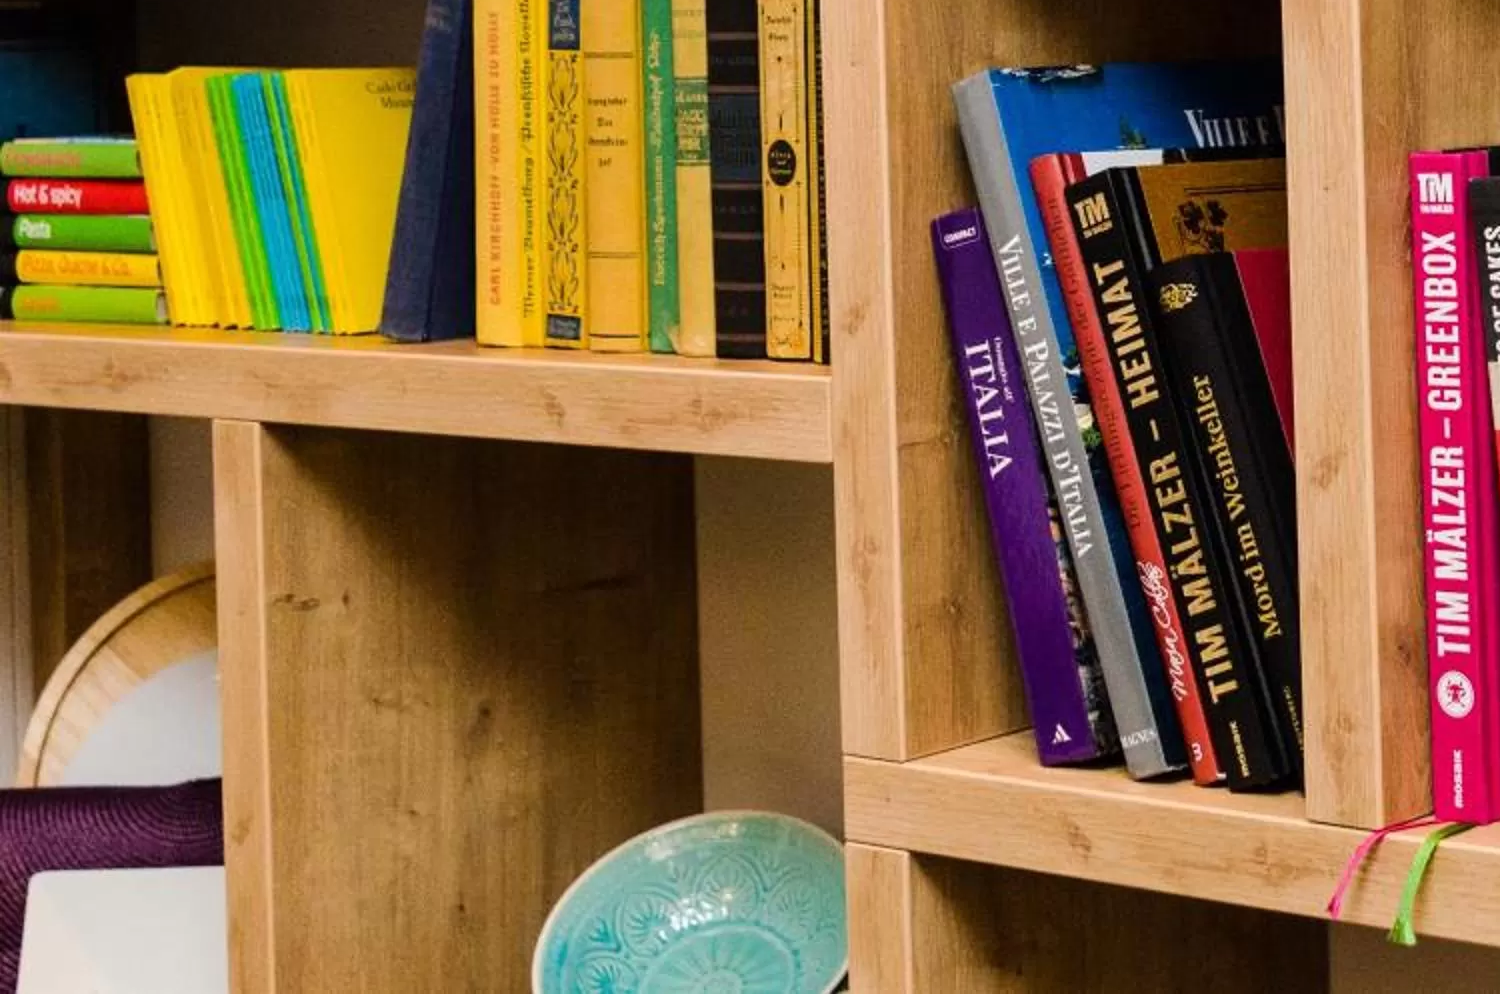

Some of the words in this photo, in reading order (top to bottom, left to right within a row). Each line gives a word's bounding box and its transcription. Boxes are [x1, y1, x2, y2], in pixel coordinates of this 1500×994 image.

[13, 183, 37, 205] Hot
[49, 185, 83, 209] spicy
[1416, 172, 1455, 203] TIM
[19, 217, 51, 239] Pasta
[490, 268, 501, 306] CARL
[998, 233, 1031, 311] VILLE
[1017, 319, 1037, 335] E
[1093, 260, 1159, 409] HEIMAT
[1420, 231, 1464, 412] GREENBOX
[964, 339, 1013, 479] ITALIA
[1026, 341, 1066, 447] PALAZZI
[1192, 374, 1247, 514] Weinkeller
[1052, 451, 1094, 558] D'ITALIA
[1149, 450, 1219, 617] MÄLZER
[1235, 521, 1259, 562] im
[1426, 445, 1469, 582] MÄLZER
[1244, 562, 1283, 640] Mord
[1434, 590, 1472, 658] TIM
[1195, 623, 1239, 705] TIM
